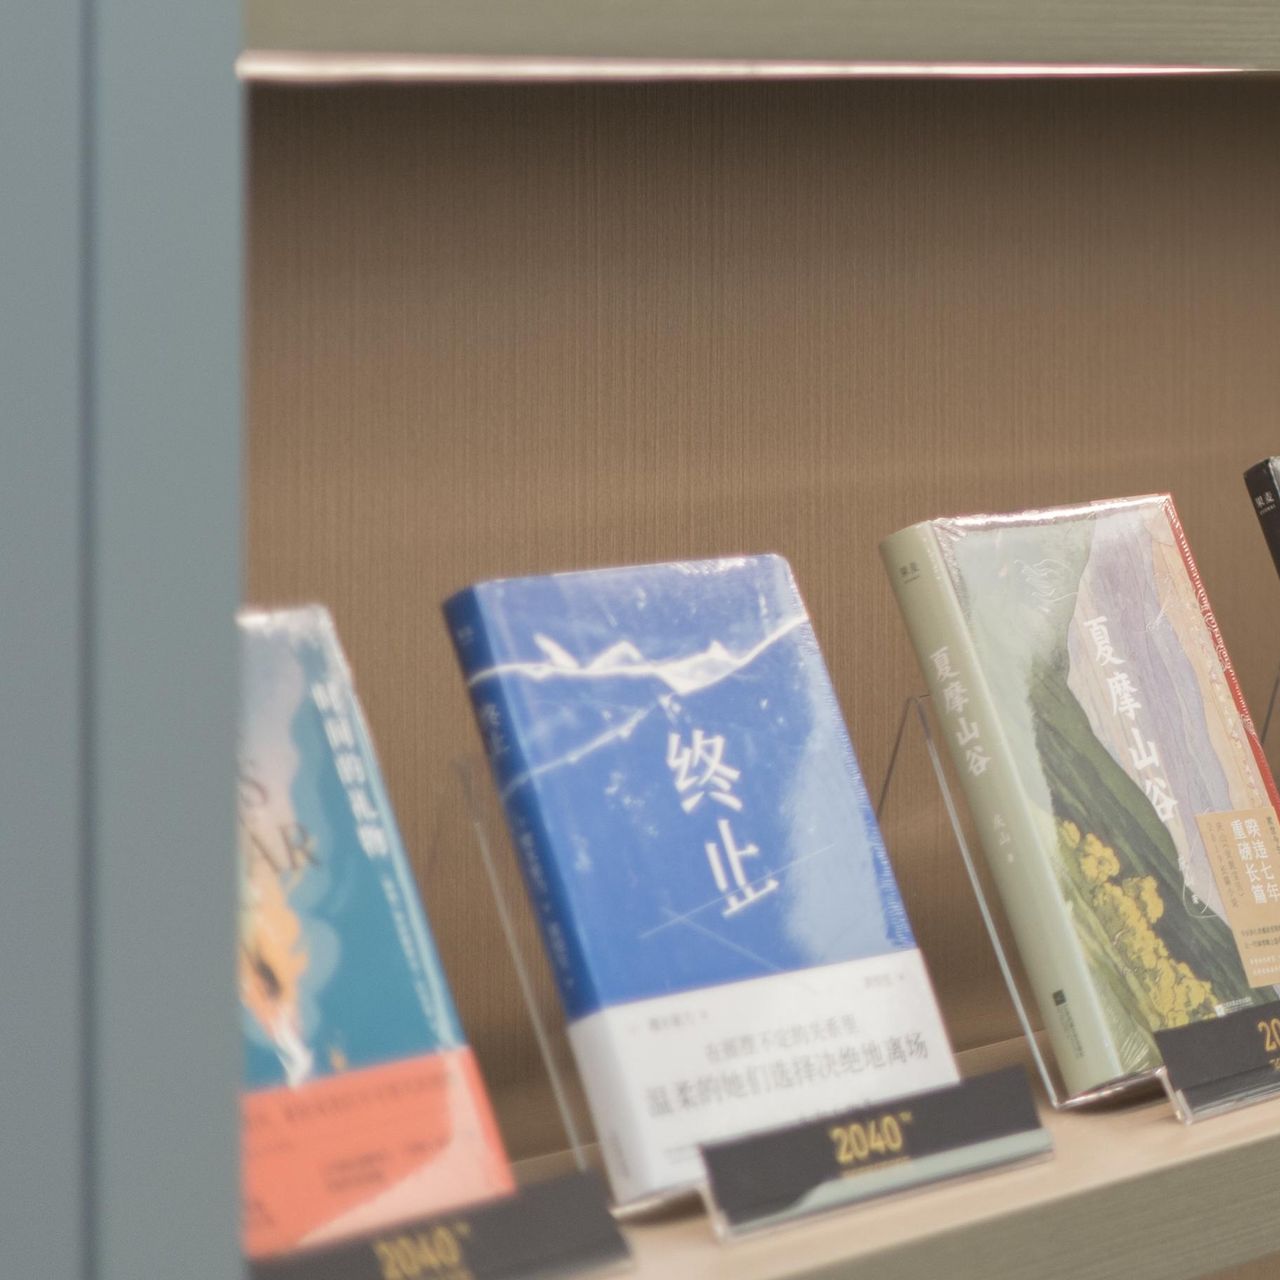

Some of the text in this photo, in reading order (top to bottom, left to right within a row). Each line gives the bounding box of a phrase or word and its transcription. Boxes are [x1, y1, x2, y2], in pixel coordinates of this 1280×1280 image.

[930, 646, 992, 777] 夏摩山谷
[1084, 616, 1178, 822] 夏摩山谷
[666, 729, 780, 919] 终止
